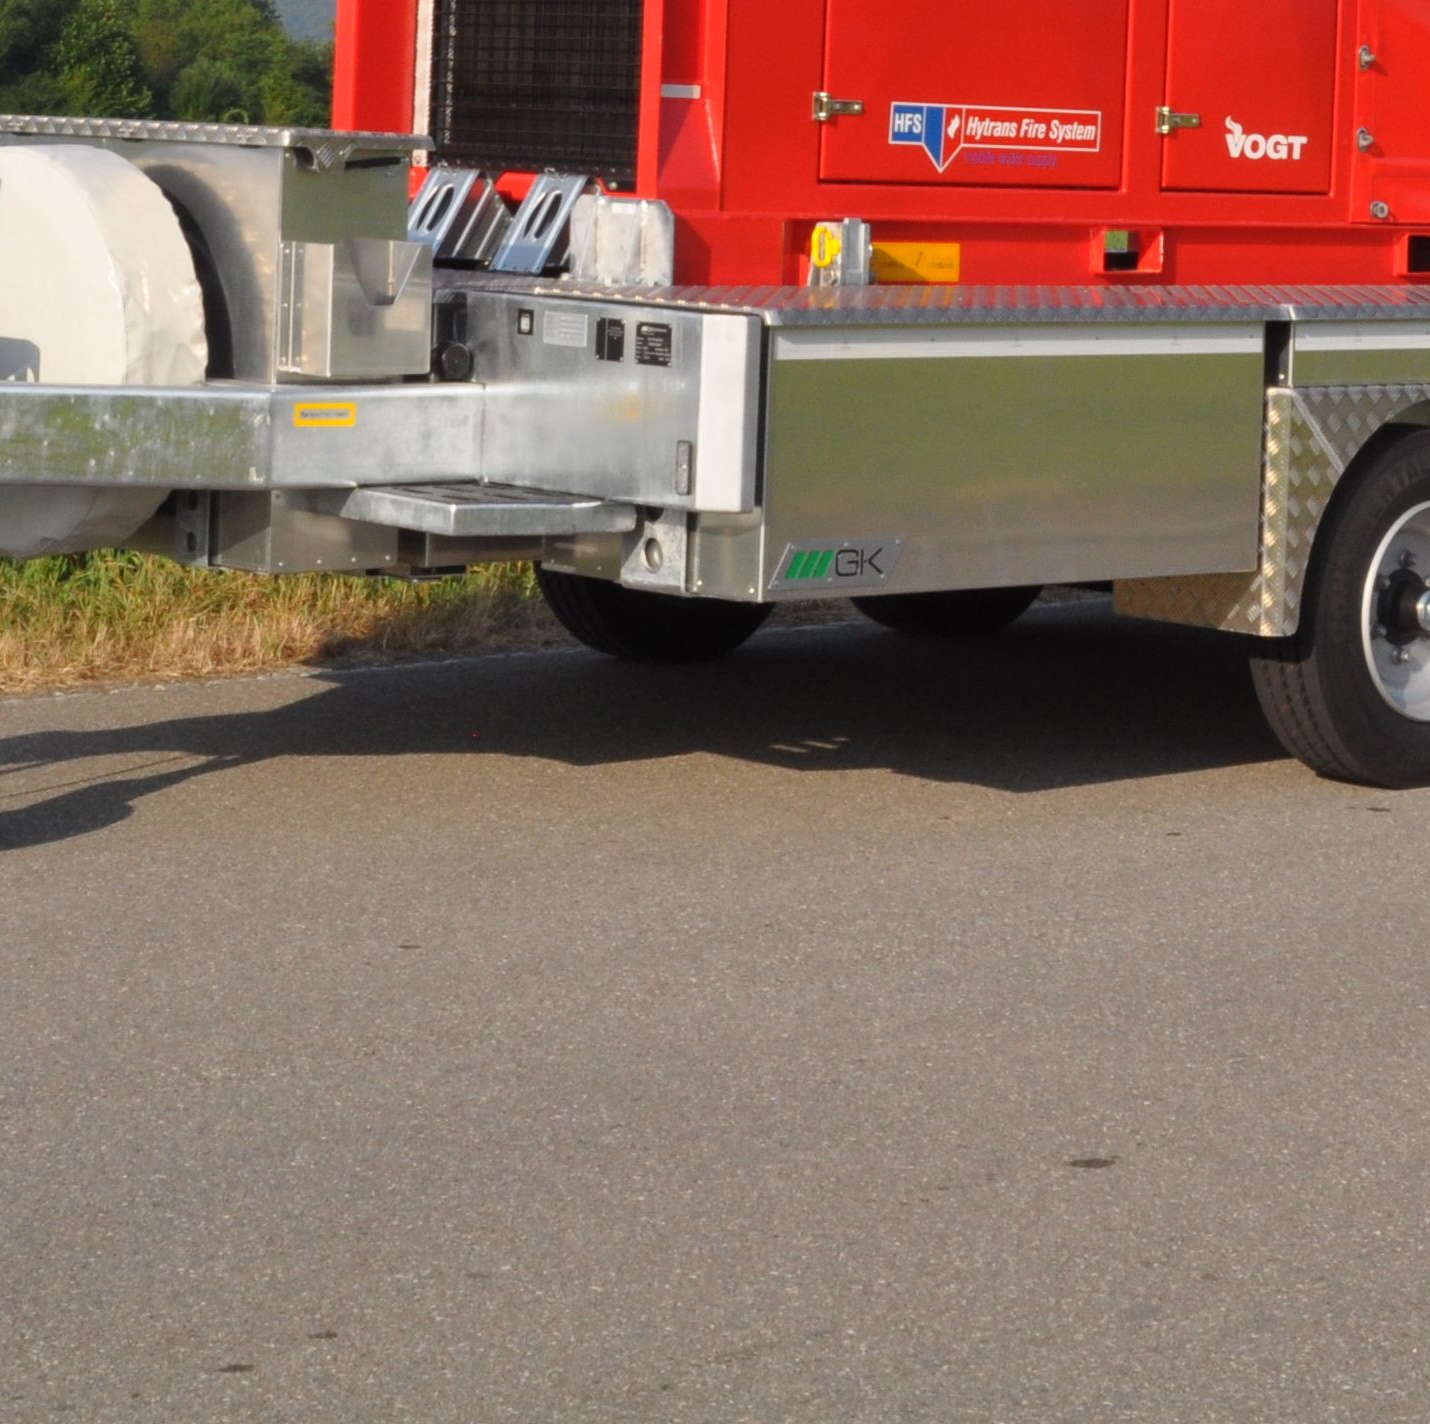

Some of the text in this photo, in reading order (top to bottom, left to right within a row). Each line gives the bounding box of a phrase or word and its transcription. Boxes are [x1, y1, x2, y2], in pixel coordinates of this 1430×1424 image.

[893, 112, 923, 135] HFS
[965, 115, 1097, 144] Hytrans Fire System
[1224, 124, 1309, 161] VOGT
[835, 547, 884, 577] GK
